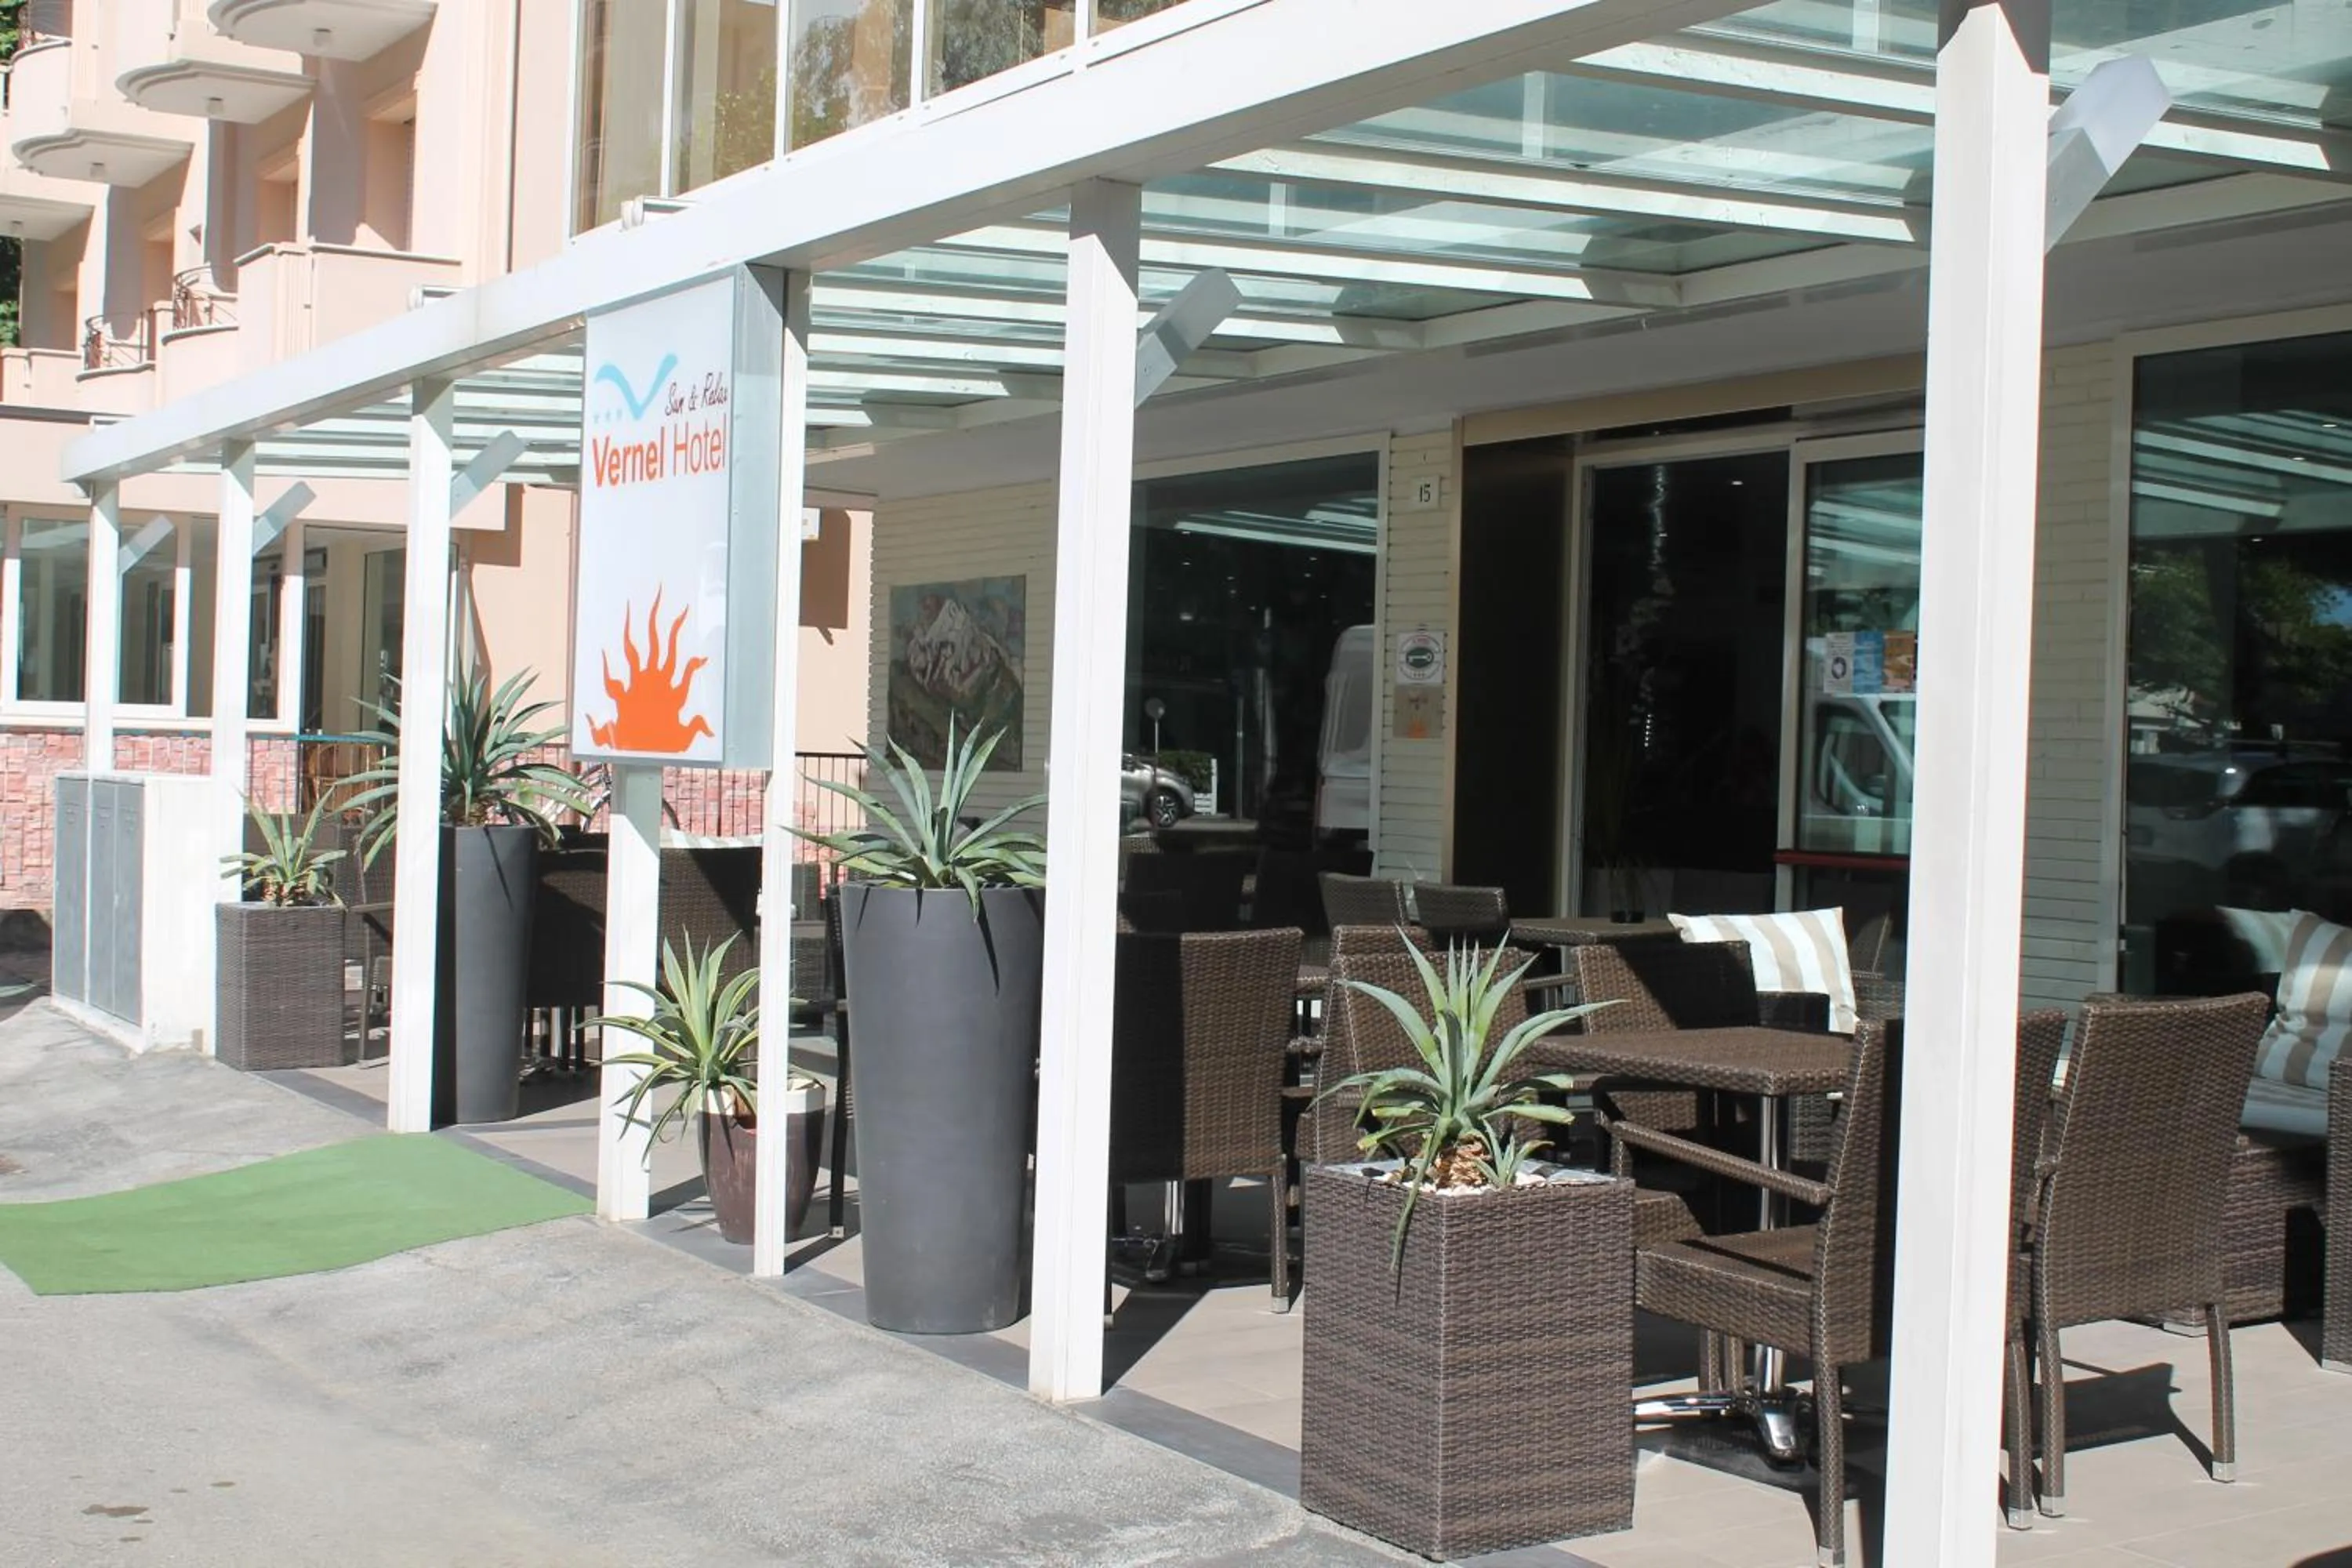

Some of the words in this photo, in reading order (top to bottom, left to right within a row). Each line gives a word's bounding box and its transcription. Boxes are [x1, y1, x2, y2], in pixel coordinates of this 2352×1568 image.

[665, 382, 684, 416] Sun
[688, 383, 699, 412] &
[592, 426, 665, 488] Vernel
[673, 412, 727, 477] Hotel
[1420, 483, 1431, 503] 15
